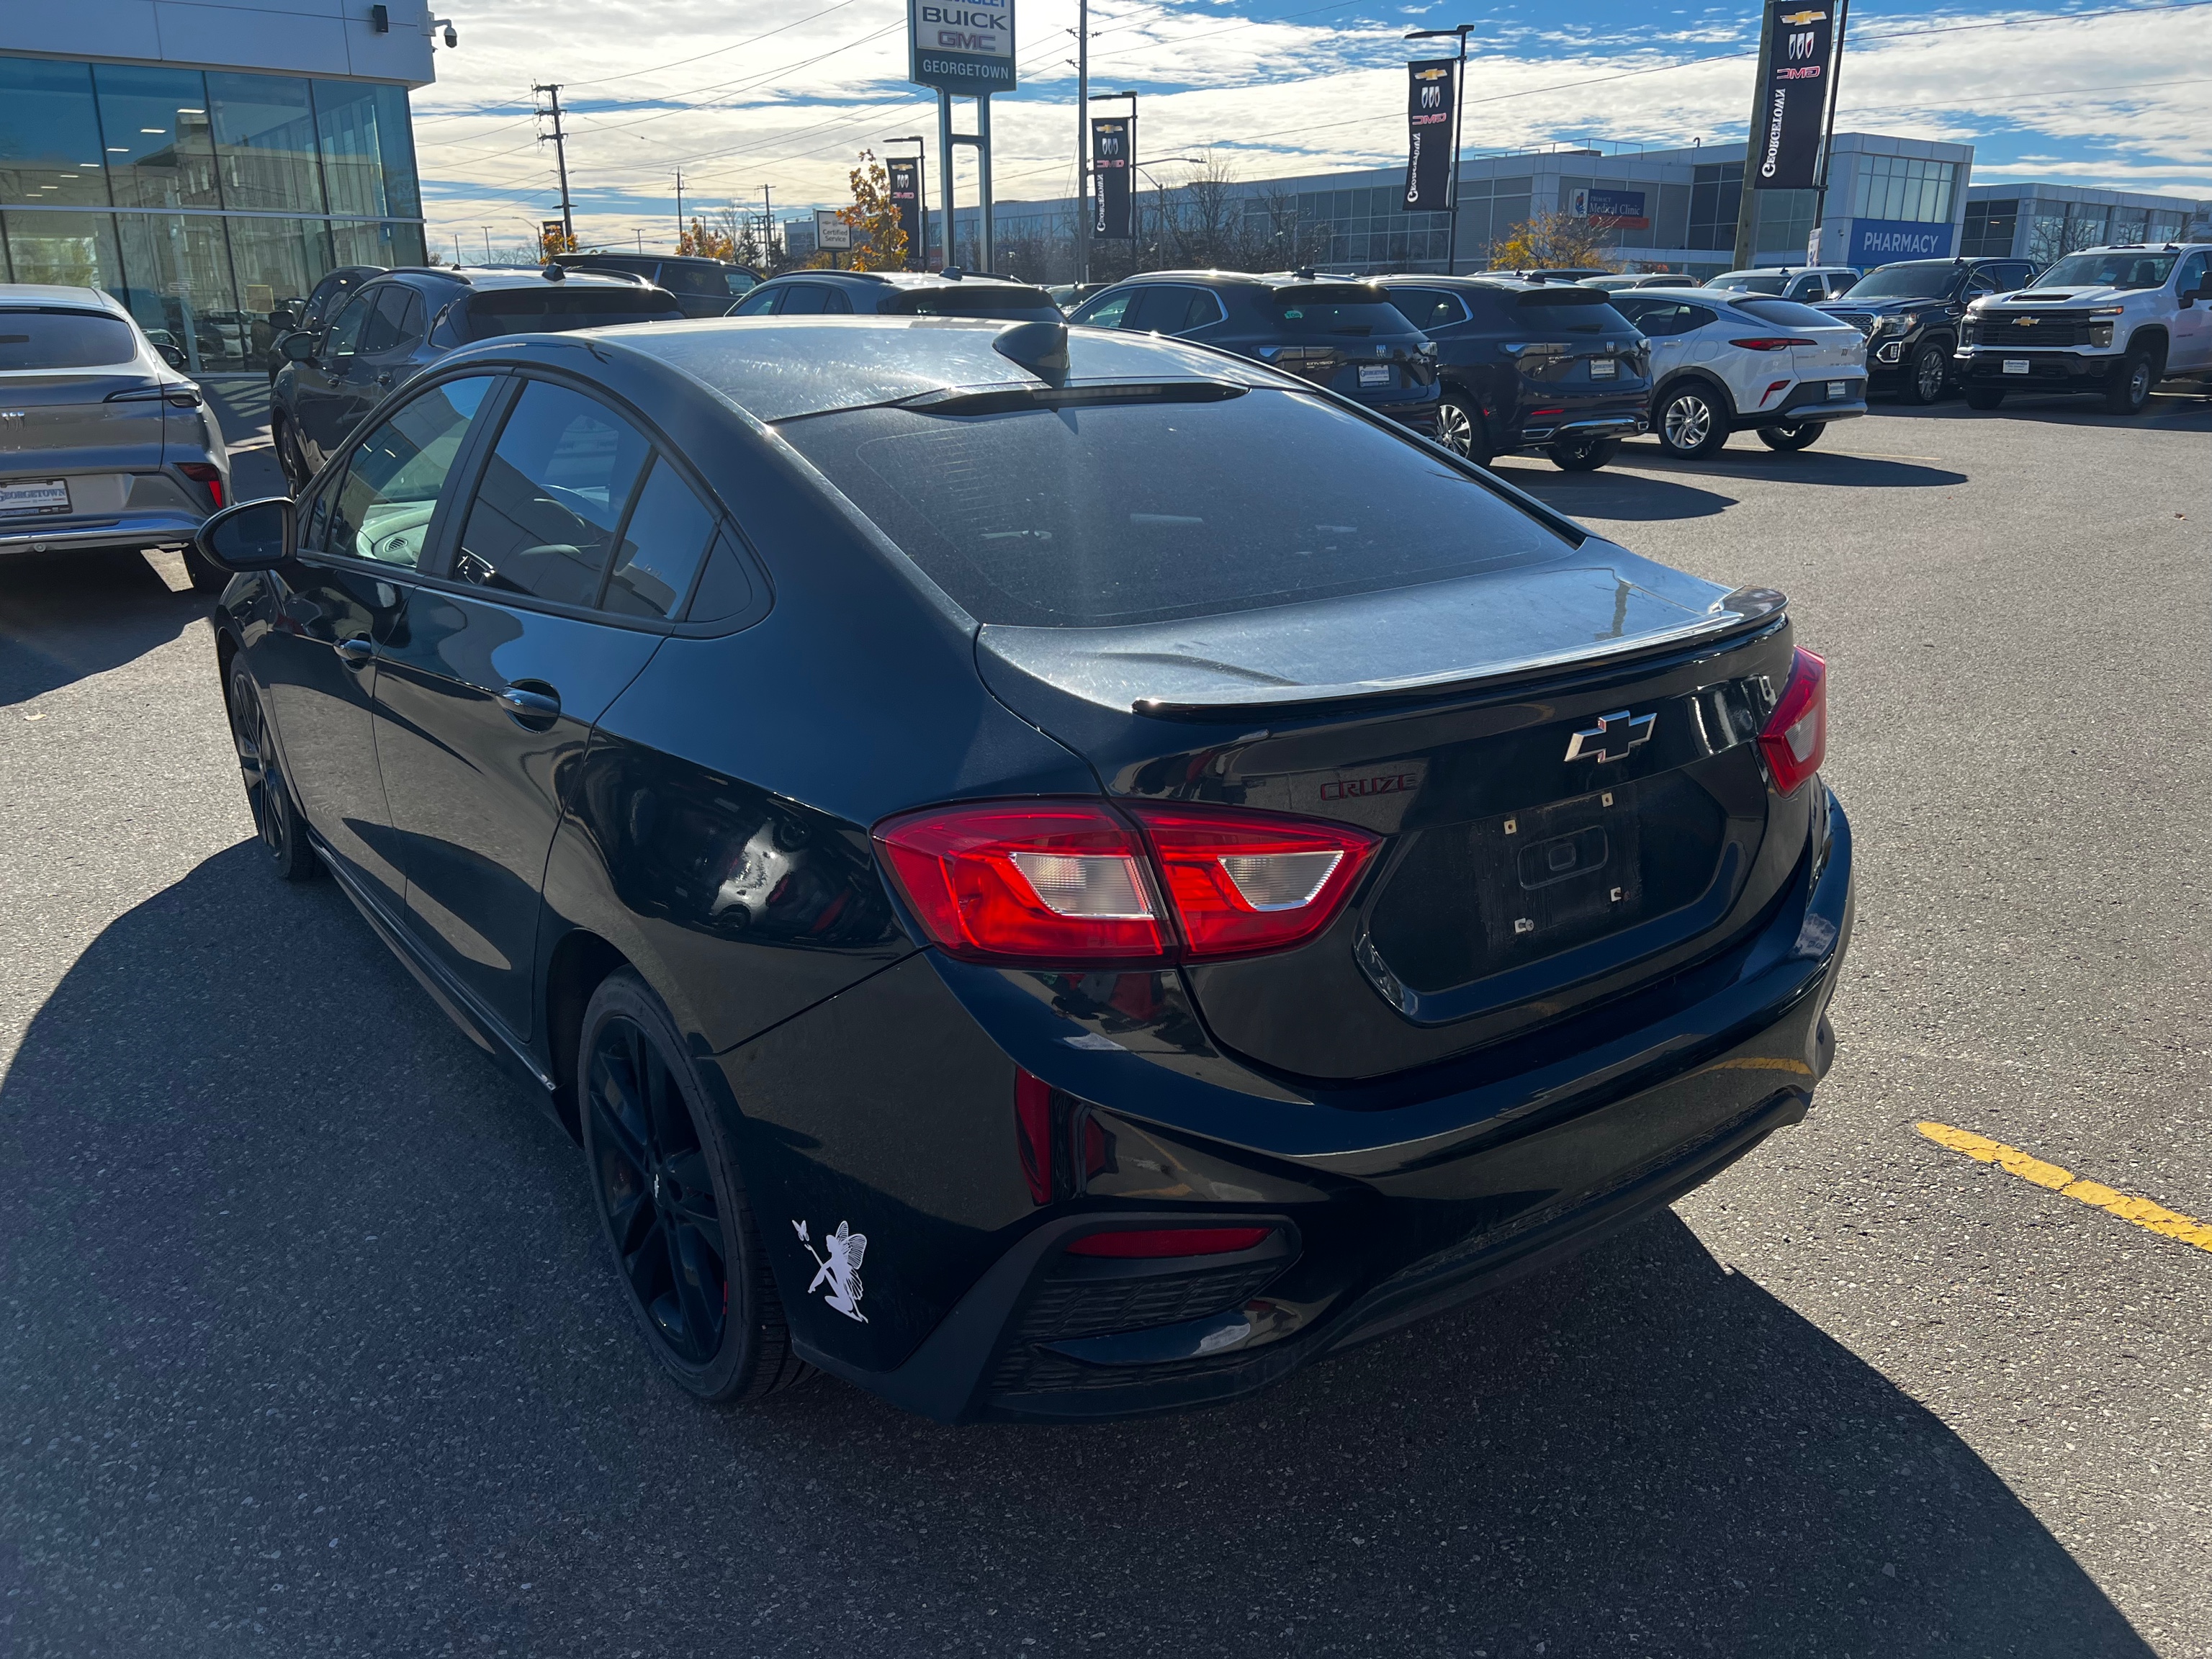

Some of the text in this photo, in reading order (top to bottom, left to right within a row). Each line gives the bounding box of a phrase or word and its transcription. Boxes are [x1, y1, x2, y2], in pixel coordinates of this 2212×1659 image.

[922, 6, 1007, 30] BUICK
[938, 30, 996, 52] GMC
[923, 59, 1008, 79] GEORGETOWN
[1589, 202, 1640, 215] Medical Clinic
[1863, 232, 1938, 253] PHARMACY
[1321, 773, 1417, 801] CRUZE
